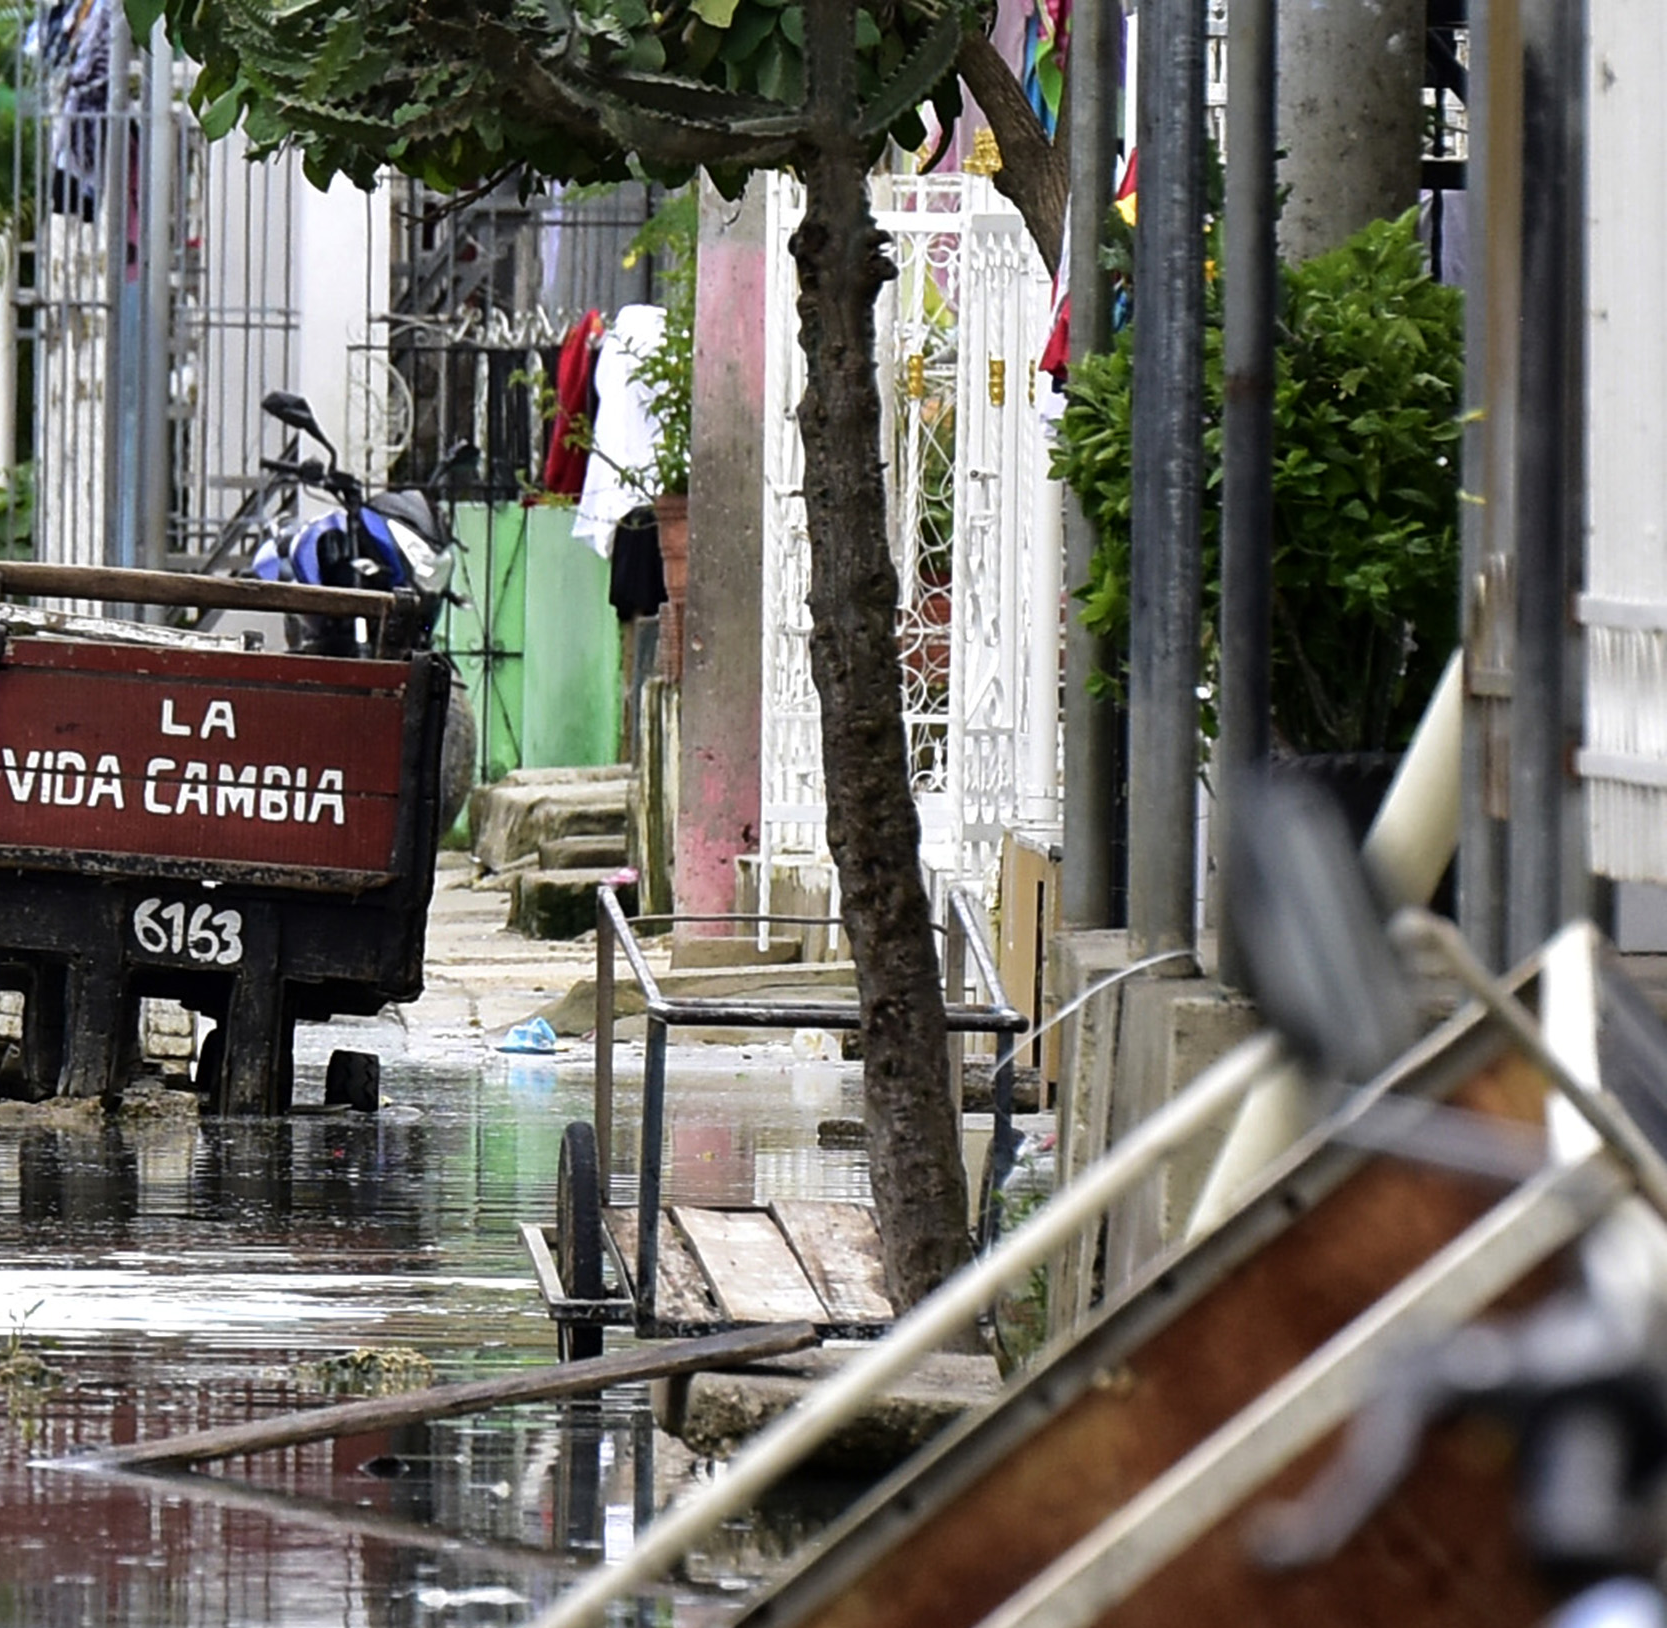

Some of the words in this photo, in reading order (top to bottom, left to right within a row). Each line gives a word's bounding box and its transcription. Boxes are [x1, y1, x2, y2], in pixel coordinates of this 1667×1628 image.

[161, 699, 237, 739] LA
[2, 748, 125, 809] VIDA
[144, 757, 345, 824] CAMBIA
[133, 898, 243, 964] 6163
